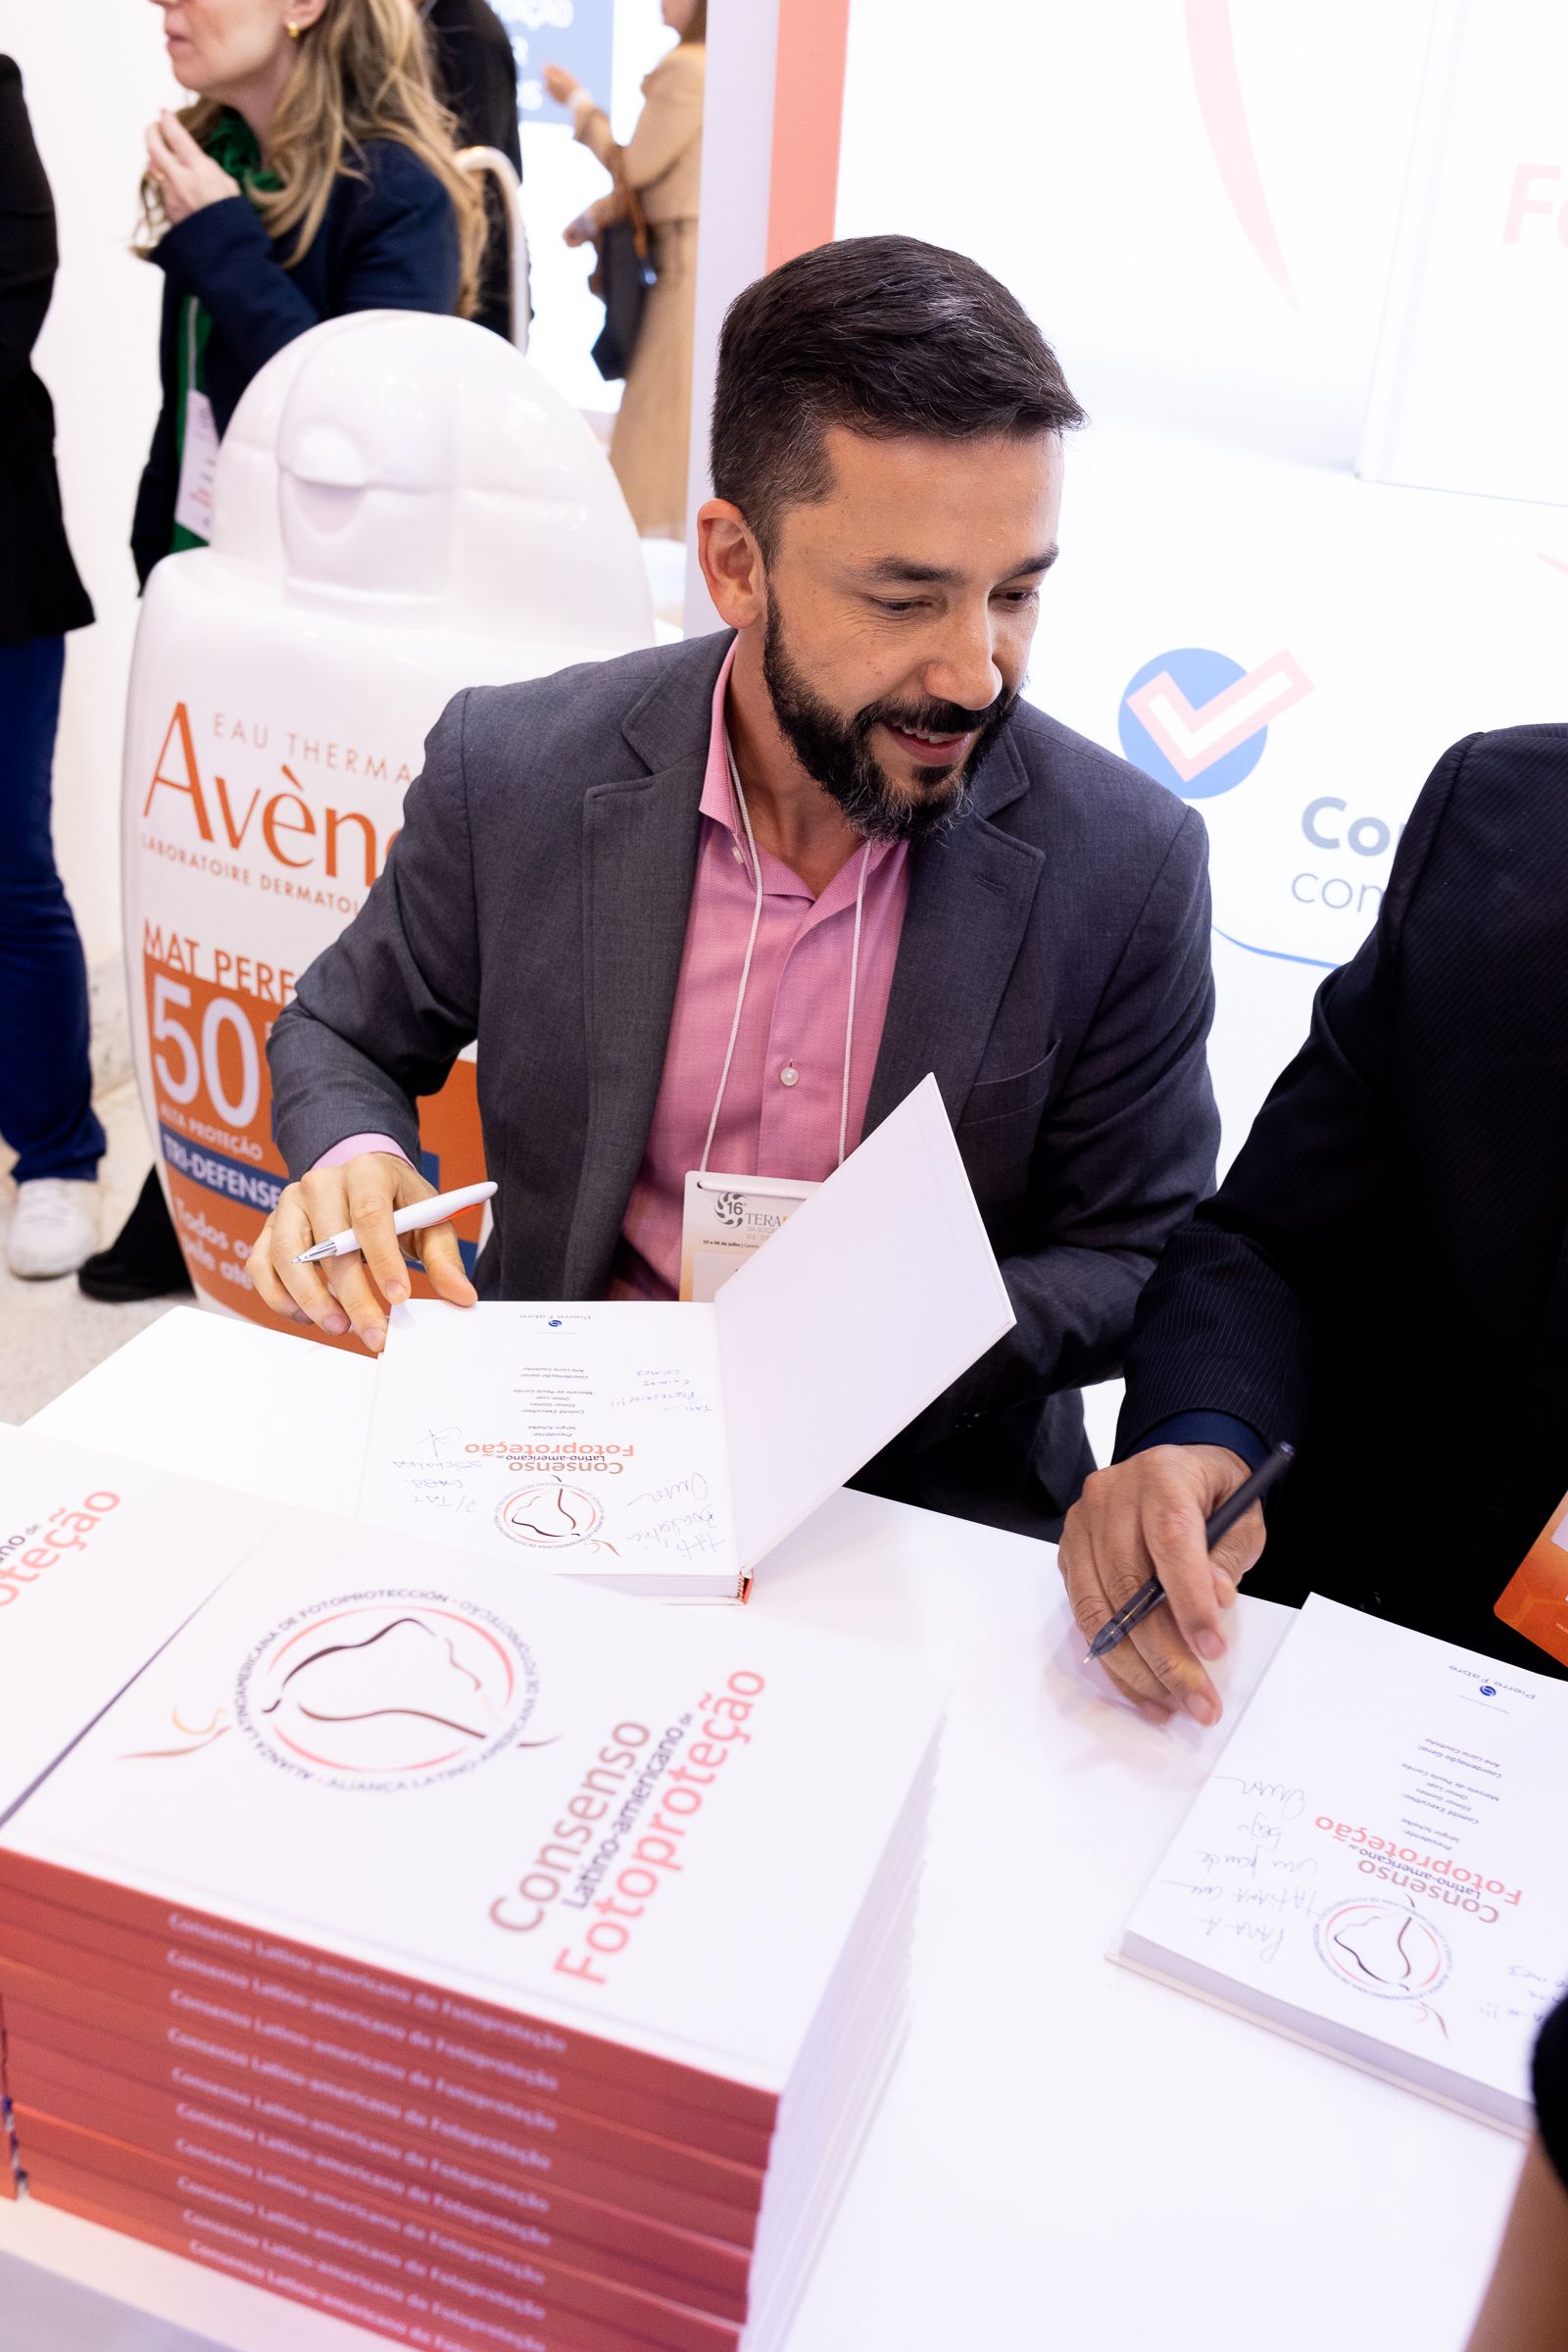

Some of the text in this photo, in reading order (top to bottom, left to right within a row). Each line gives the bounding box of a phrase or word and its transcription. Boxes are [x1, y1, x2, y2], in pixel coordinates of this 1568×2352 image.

[143, 702, 404, 888] Avèn
[214, 712, 413, 784] EAU THERMA
[142, 833, 250, 885] LABORATOIRE
[1301, 796, 1406, 857] Co
[143, 916, 295, 1004] MAT PERF
[152, 972, 261, 1128] 50
[464, 1442, 635, 1457] Fotoproteção
[508, 1461, 624, 1475] Consenso
[277, 1616, 297, 1633] DE
[299, 1589, 449, 1619] FOTOPROTECCIÓN
[1448, 1665, 1536, 1699] Pierre Fabre
[488, 1721, 651, 1934] Consenso
[552, 1669, 766, 1986] Fotoproteção
[562, 1726, 684, 1910] Latino-americano
[1315, 1815, 1522, 1906] Fotoproteção
[1357, 1859, 1499, 1924] Consenso
[1359, 1847, 1481, 1899] Latino-americano
[166, 1948, 251, 1989] Consenso
[408, 2030, 433, 2049] de
[168, 1912, 254, 1952] Consenso
[414, 1993, 439, 2012] de
[167, 2027, 250, 2067] Consenso
[403, 2109, 428, 2128] de
[169, 1988, 253, 2029] Consenso
[408, 2070, 433, 2089] de
[171, 2067, 252, 2107] Consenso
[404, 2151, 428, 2169] de
[175, 2102, 257, 2142] Consenso
[407, 2185, 431, 2203] de
[174, 2137, 255, 2177] Consenso
[403, 2223, 426, 2241] de
[176, 2176, 256, 2215] Consenso
[403, 2259, 427, 2277] de
[182, 2209, 260, 2248] Consenso
[406, 2293, 429, 2312] de
[188, 2239, 266, 2278] Consenso
[408, 2327, 432, 2344] de
